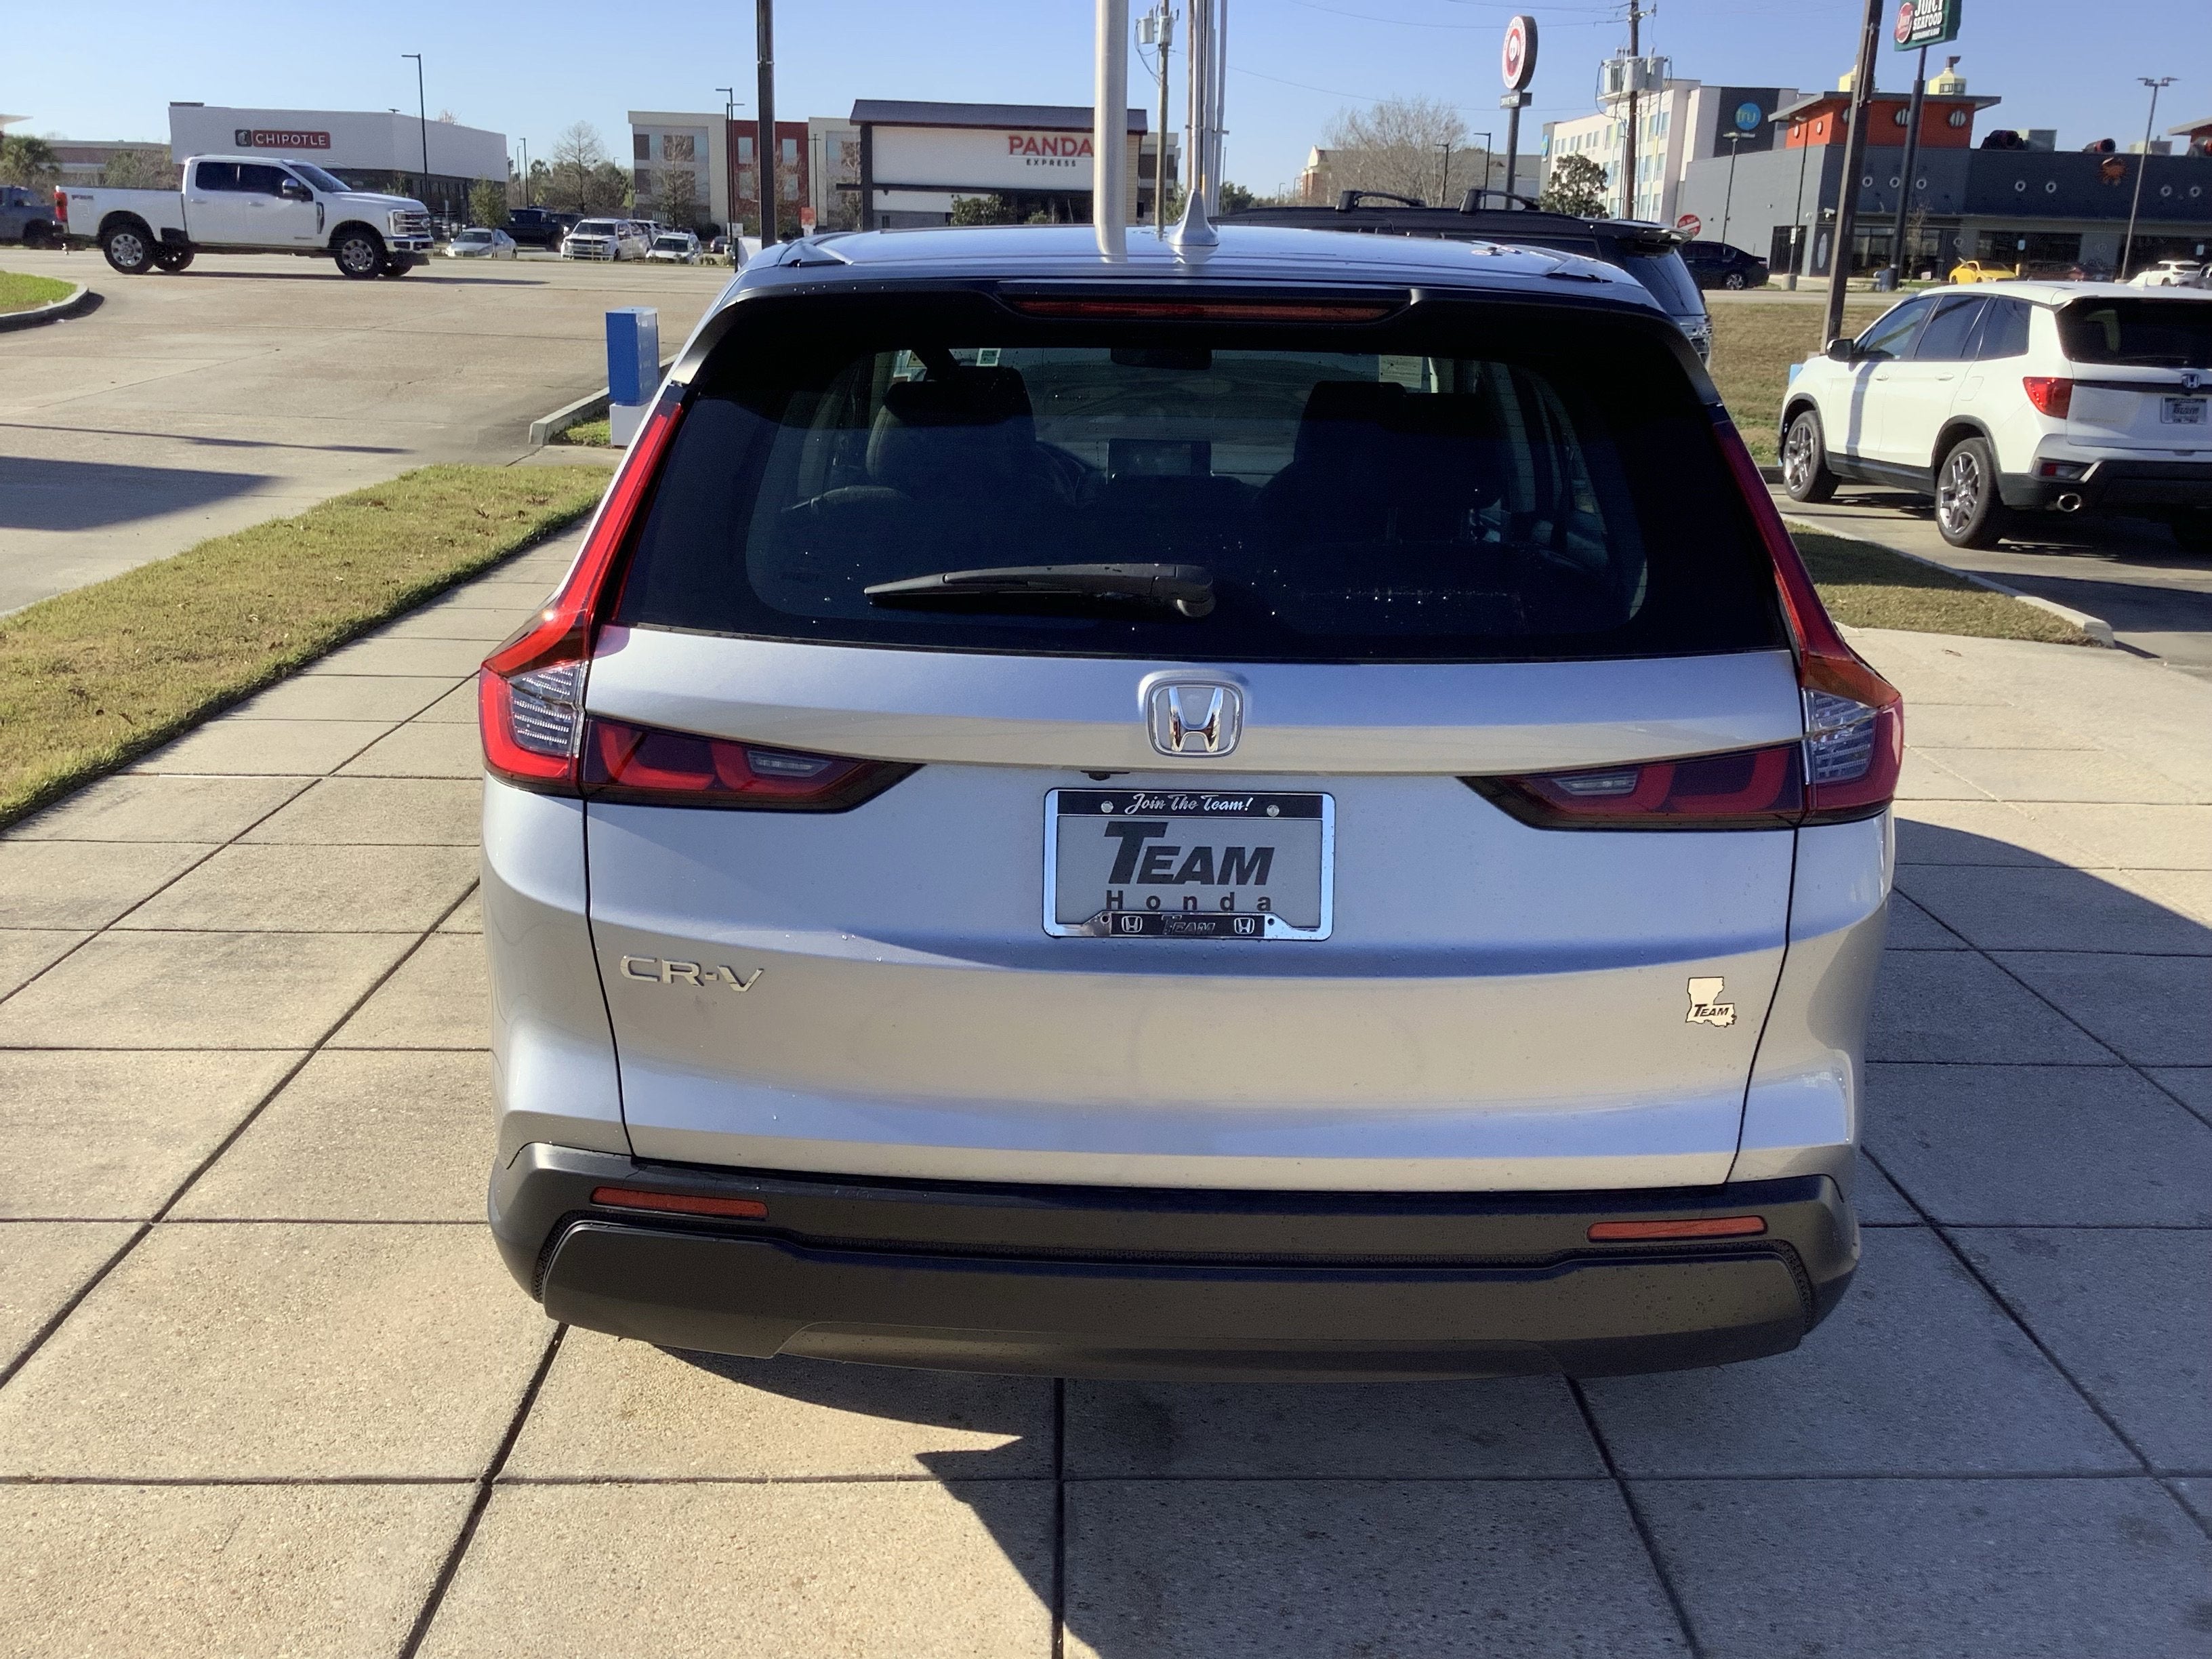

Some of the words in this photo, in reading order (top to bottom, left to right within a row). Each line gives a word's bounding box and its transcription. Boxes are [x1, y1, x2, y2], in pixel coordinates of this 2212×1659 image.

[1912, 11, 1943, 30] SEAFOOD
[255, 134, 326, 146] CHIPOTLE
[1008, 135, 1094, 157] PANDA
[1026, 158, 1077, 167] EXPRESS
[1124, 793, 1166, 815] Join
[1167, 794, 1198, 811] The
[1200, 794, 1254, 812] Team!
[1104, 821, 1275, 885] TEAM
[1106, 890, 1271, 912] Honda
[1161, 914, 1216, 935] TEAM
[619, 954, 764, 992] CR-V
[1694, 1004, 1729, 1017] TEAM
